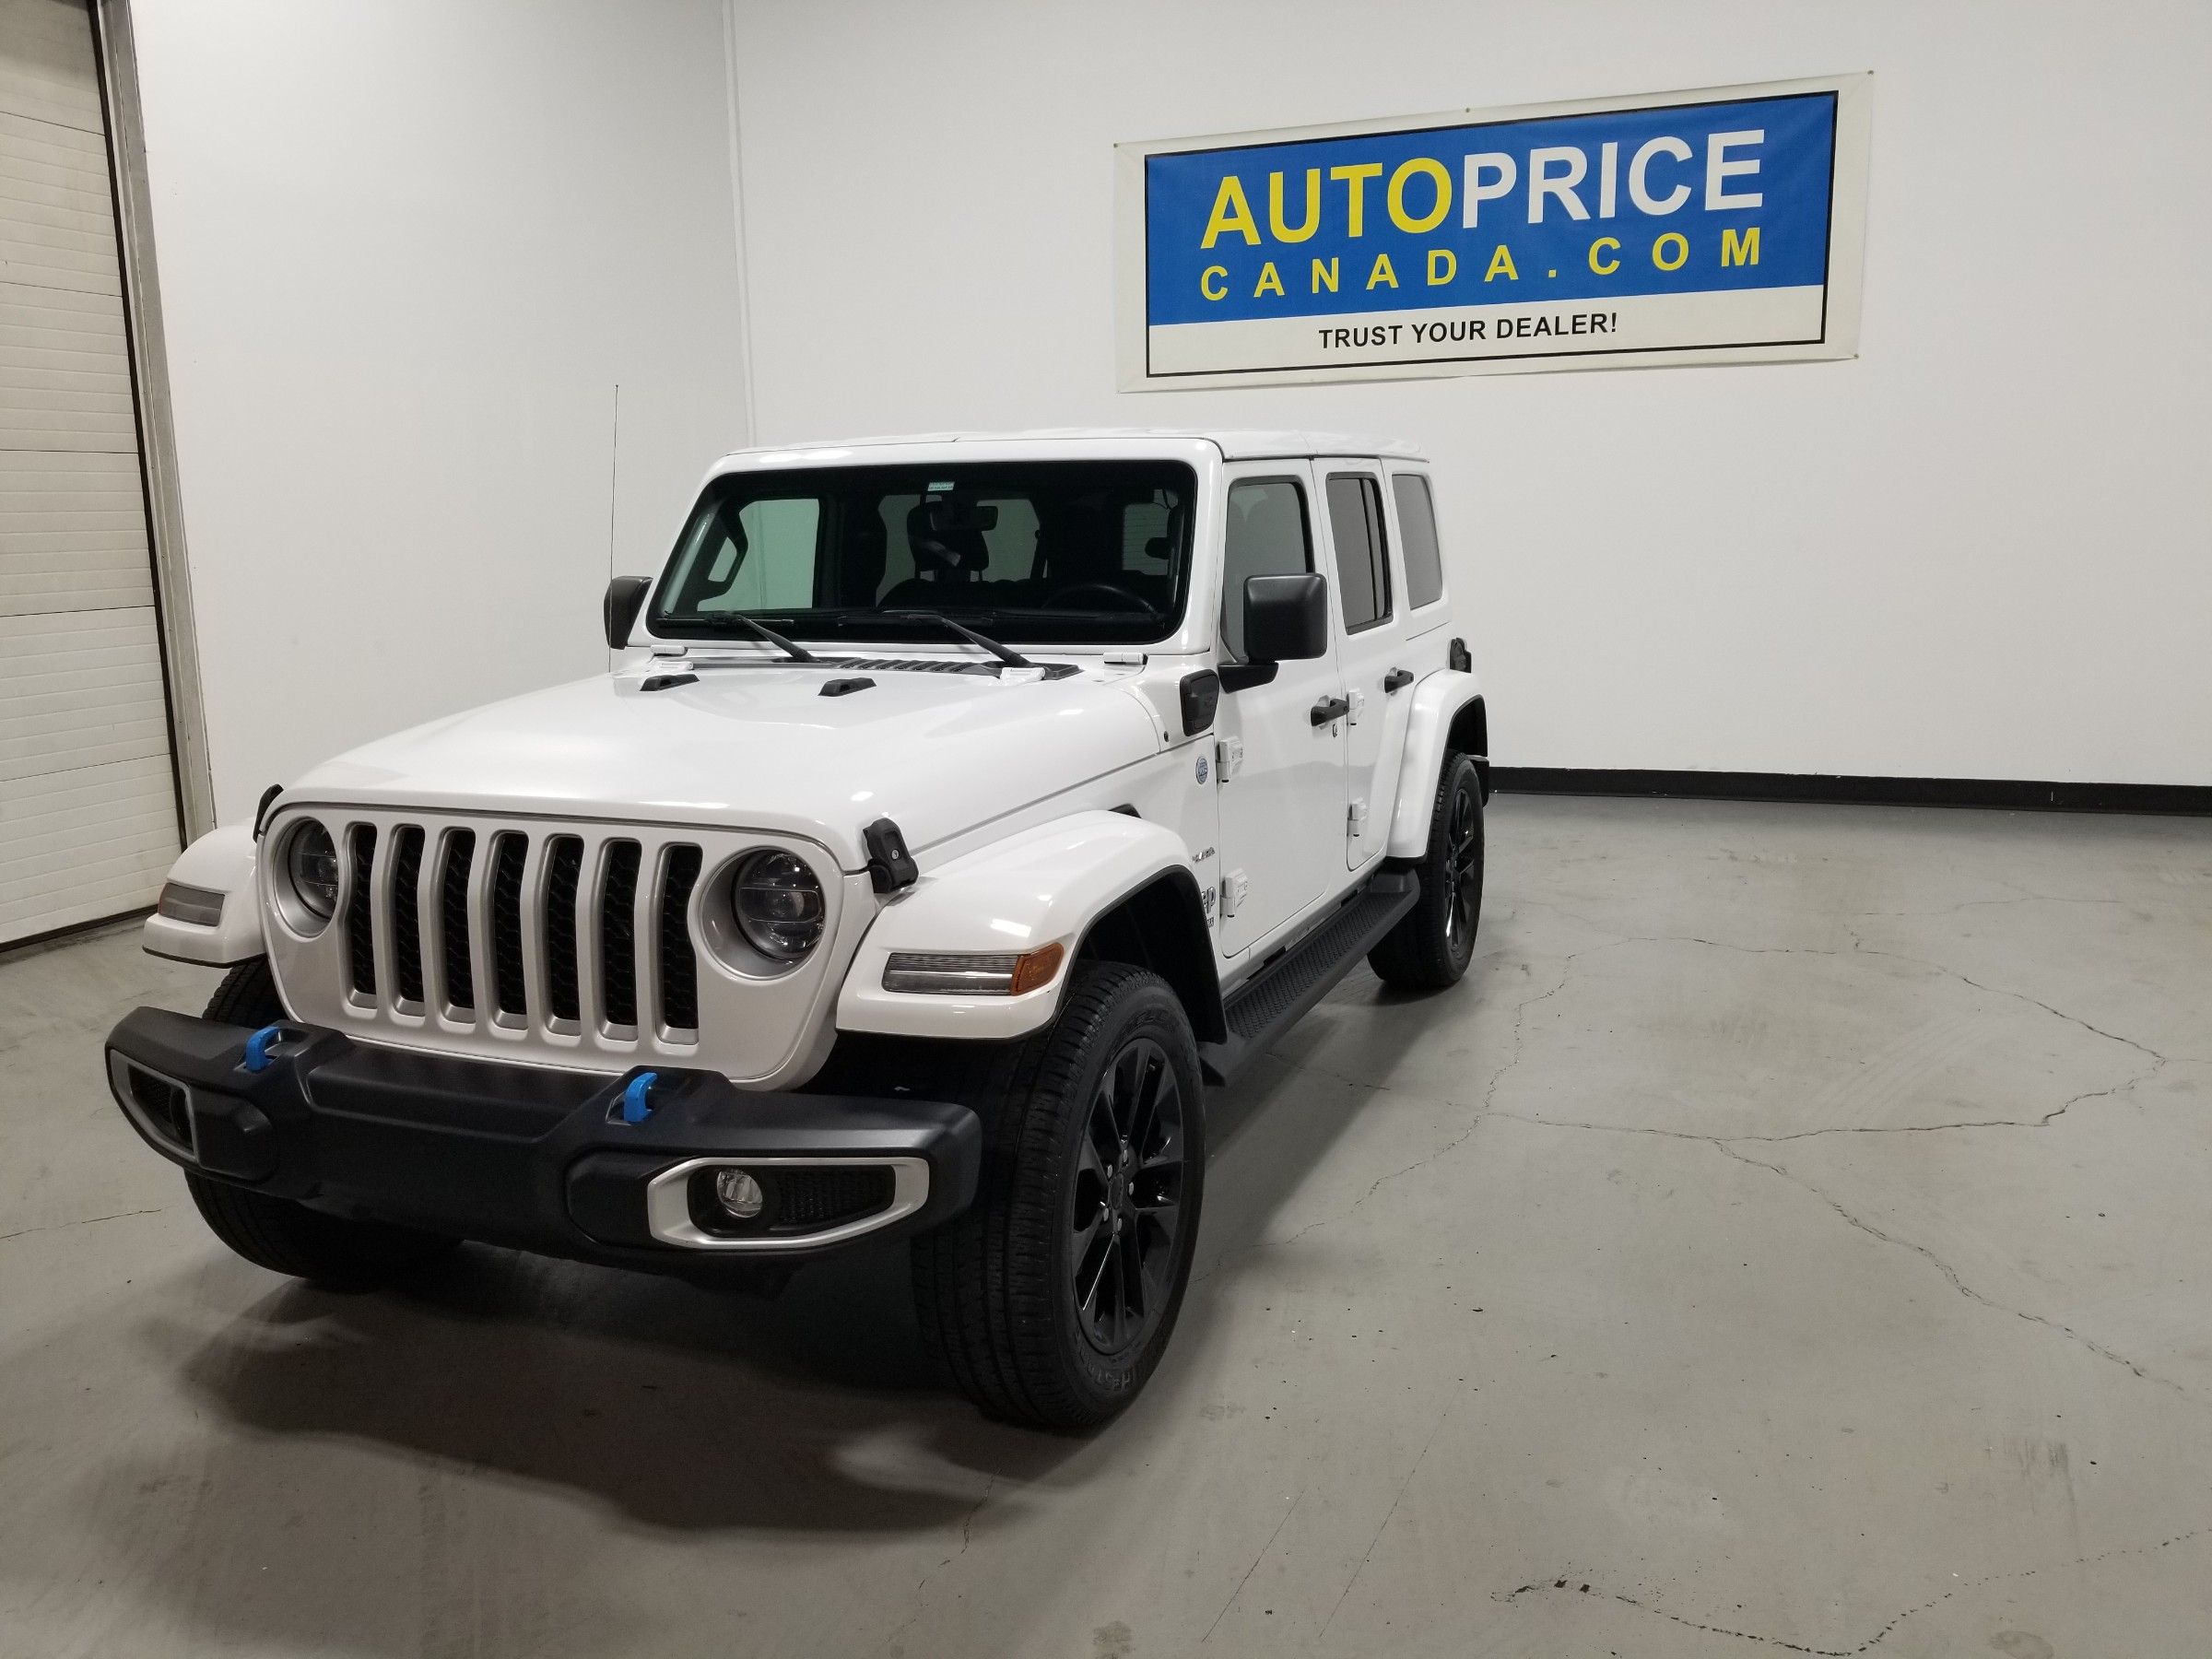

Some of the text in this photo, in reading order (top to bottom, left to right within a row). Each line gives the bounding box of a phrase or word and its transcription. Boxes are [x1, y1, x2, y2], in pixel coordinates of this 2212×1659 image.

[1201, 129, 1765, 248] AUTOPRICE
[1318, 312, 1618, 349] TRUST YOUR DEALER!
